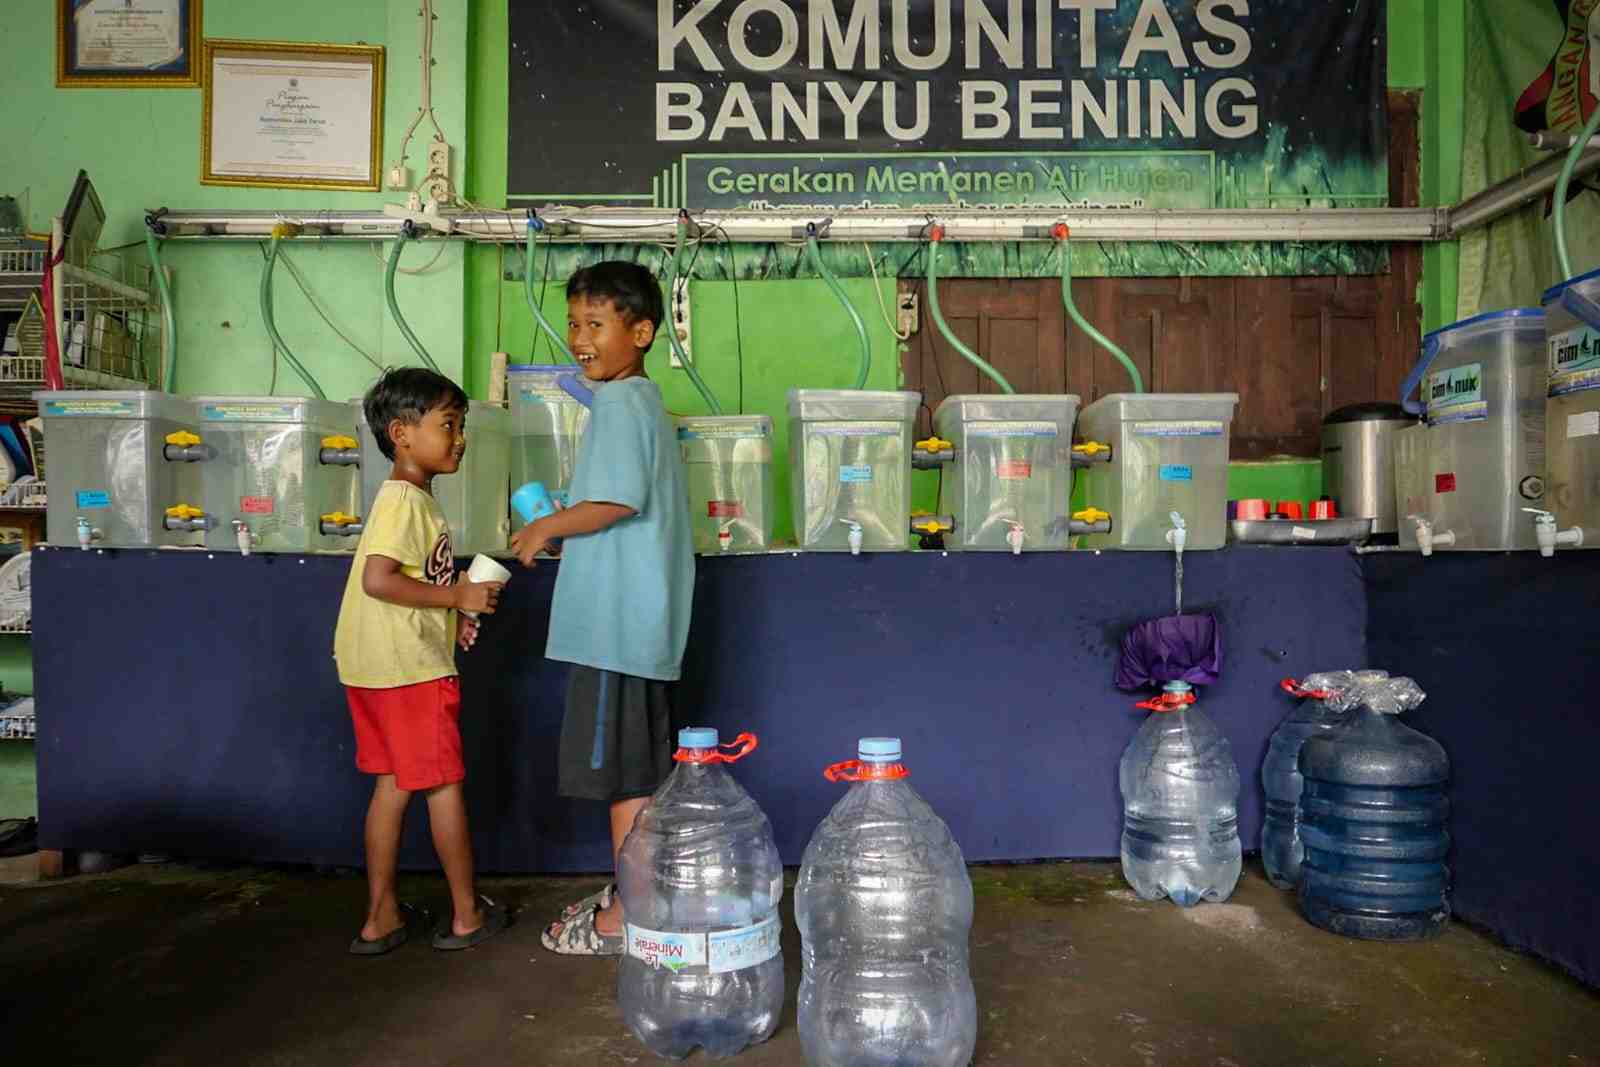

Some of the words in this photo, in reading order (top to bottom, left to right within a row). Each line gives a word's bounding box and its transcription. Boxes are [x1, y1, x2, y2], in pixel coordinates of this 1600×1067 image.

[657, 0, 1252, 72] KOMUNITAS
[655, 80, 930, 142] BANYU
[960, 78, 1259, 140] BENING
[706, 166, 855, 194] Gerakan
[865, 165, 1035, 194] Memanen
[1046, 164, 1088, 193] Air
[1099, 164, 1193, 197] Hujan
